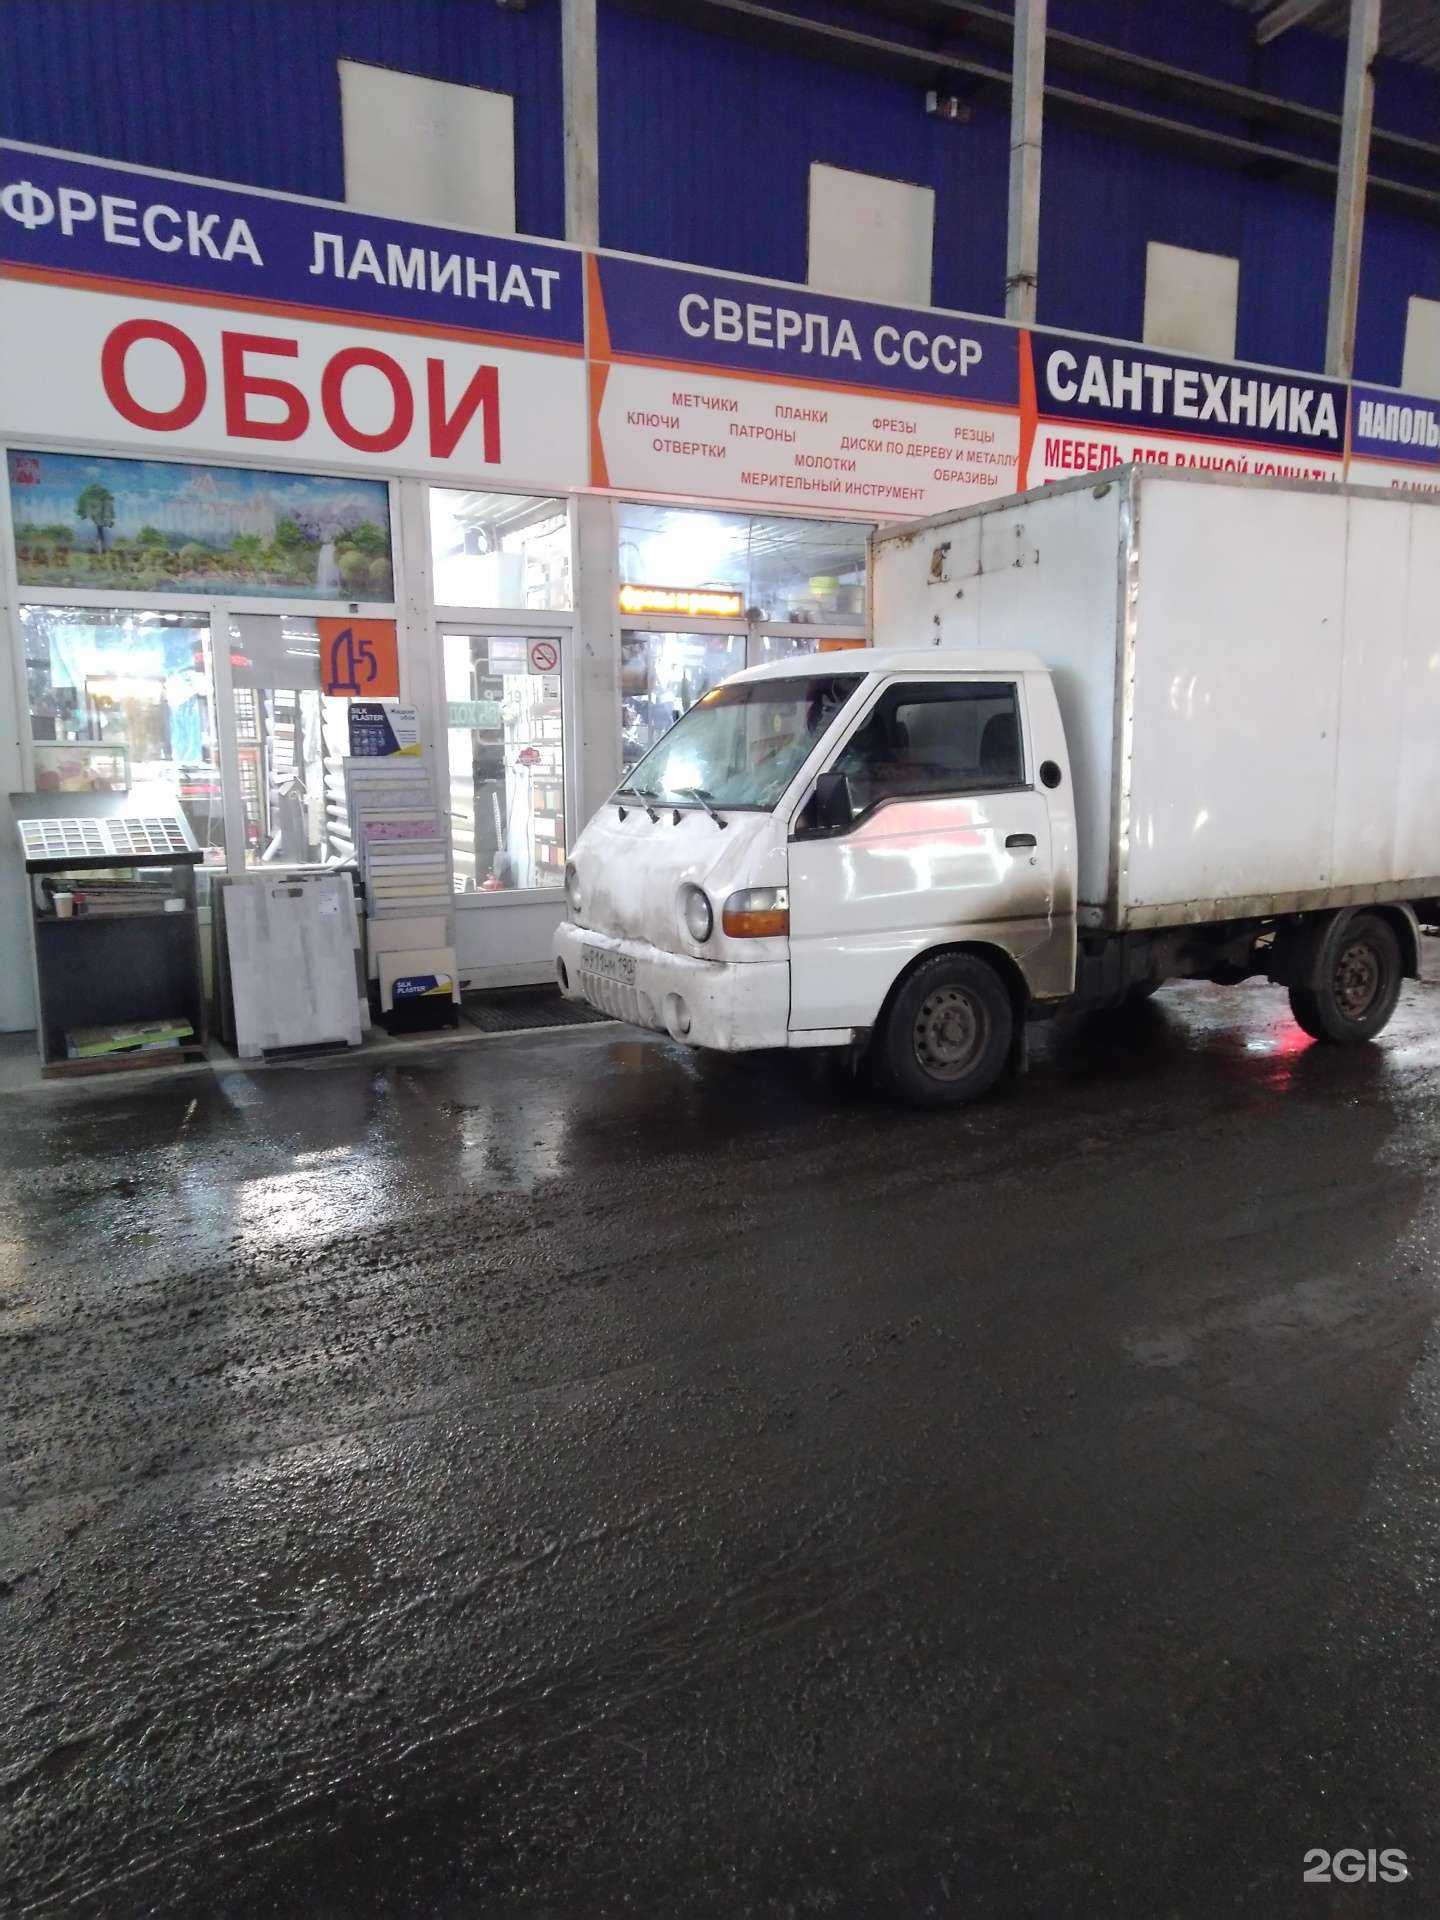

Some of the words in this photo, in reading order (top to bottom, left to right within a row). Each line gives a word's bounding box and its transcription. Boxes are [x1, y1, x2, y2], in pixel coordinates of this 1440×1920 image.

[2, 180, 264, 267] ФРЕСКА
[309, 231, 561, 310] ЛАМИНАТ
[678, 292, 862, 361] СВЕРЛА
[873, 325, 983, 376] СССР
[101, 318, 502, 464] ОБОИ
[672, 392, 738, 412] МЕТЧИКИ
[775, 405, 828, 423] ПЛАНКИ
[872, 417, 917, 435] ФРЕЗЫ
[954, 427, 995, 443] РЕЗЦЫ
[1045, 349, 1339, 439] САНТЕХНИКА
[627, 411, 680, 429] КЛЮЧИ
[729, 422, 797, 442] ПАТРОНЫ
[840, 436, 884, 454] ДИСКИ
[886, 441, 904, 454] ПО
[905, 443, 952, 462] ДЕРЕВУ
[955, 448, 965, 461] И
[966, 451, 1018, 468] МЕТАЛЛУ
[1357, 400, 1440, 449] НАПОЛЬ
[652, 438, 727, 459] ОТВЕРТКИ
[794, 454, 857, 472] МОЛОТКИ
[933, 468, 999, 487] ОБРАЗИВЫ
[1044, 437, 1124, 473] МЕБЕЛЬ
[740, 471, 842, 495] МЕРИТЕЛЬНЫЙ
[844, 482, 925, 501] ИНСТРУМЕНТ
